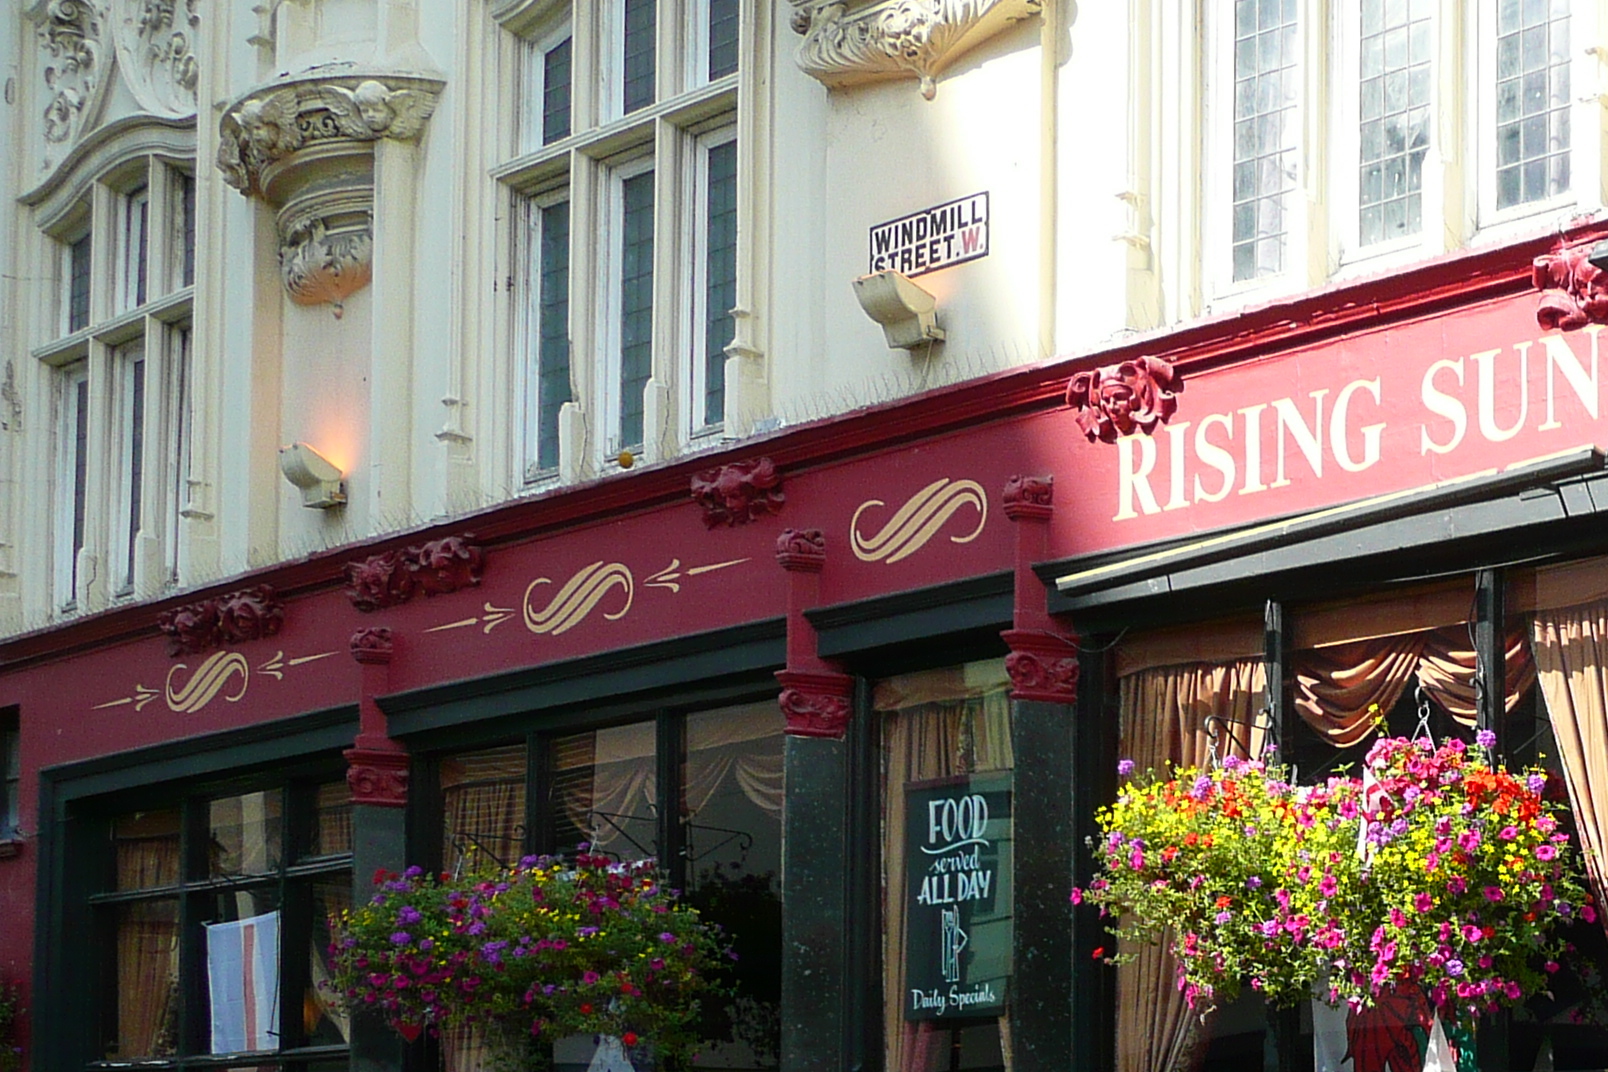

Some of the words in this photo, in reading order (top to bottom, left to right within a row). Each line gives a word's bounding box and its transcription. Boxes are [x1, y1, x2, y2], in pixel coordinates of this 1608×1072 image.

[874, 233, 960, 274] STREET.
[961, 225, 984, 254] W.
[875, 200, 983, 255] WINDMILL
[1112, 376, 1388, 522] RISING
[1420, 324, 1606, 457] SUN
[928, 794, 989, 844] FOOD
[929, 844, 981, 873] served
[917, 874, 955, 905] ALL
[957, 869, 992, 903] DAY
[911, 988, 946, 1017] Daily
[949, 982, 997, 1011] Specials
